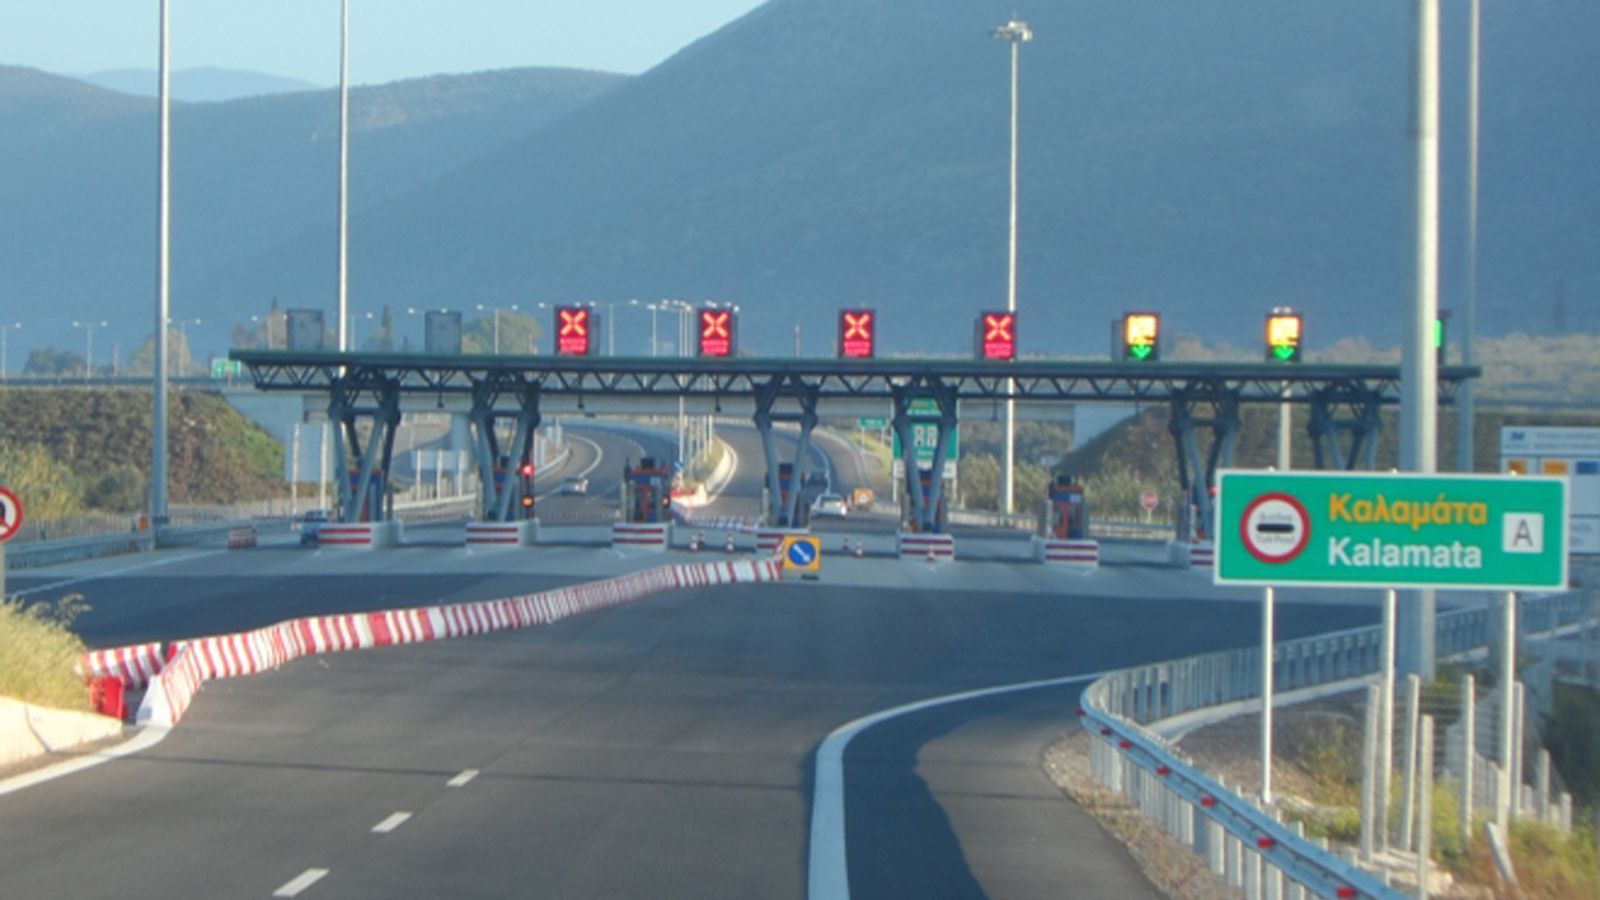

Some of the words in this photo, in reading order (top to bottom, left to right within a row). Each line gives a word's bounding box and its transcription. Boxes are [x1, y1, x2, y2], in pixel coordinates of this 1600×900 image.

[1328, 493, 1487, 530] Καλαμάτα
[1512, 519, 1534, 547] A
[1328, 537, 1482, 568] Kalamata
